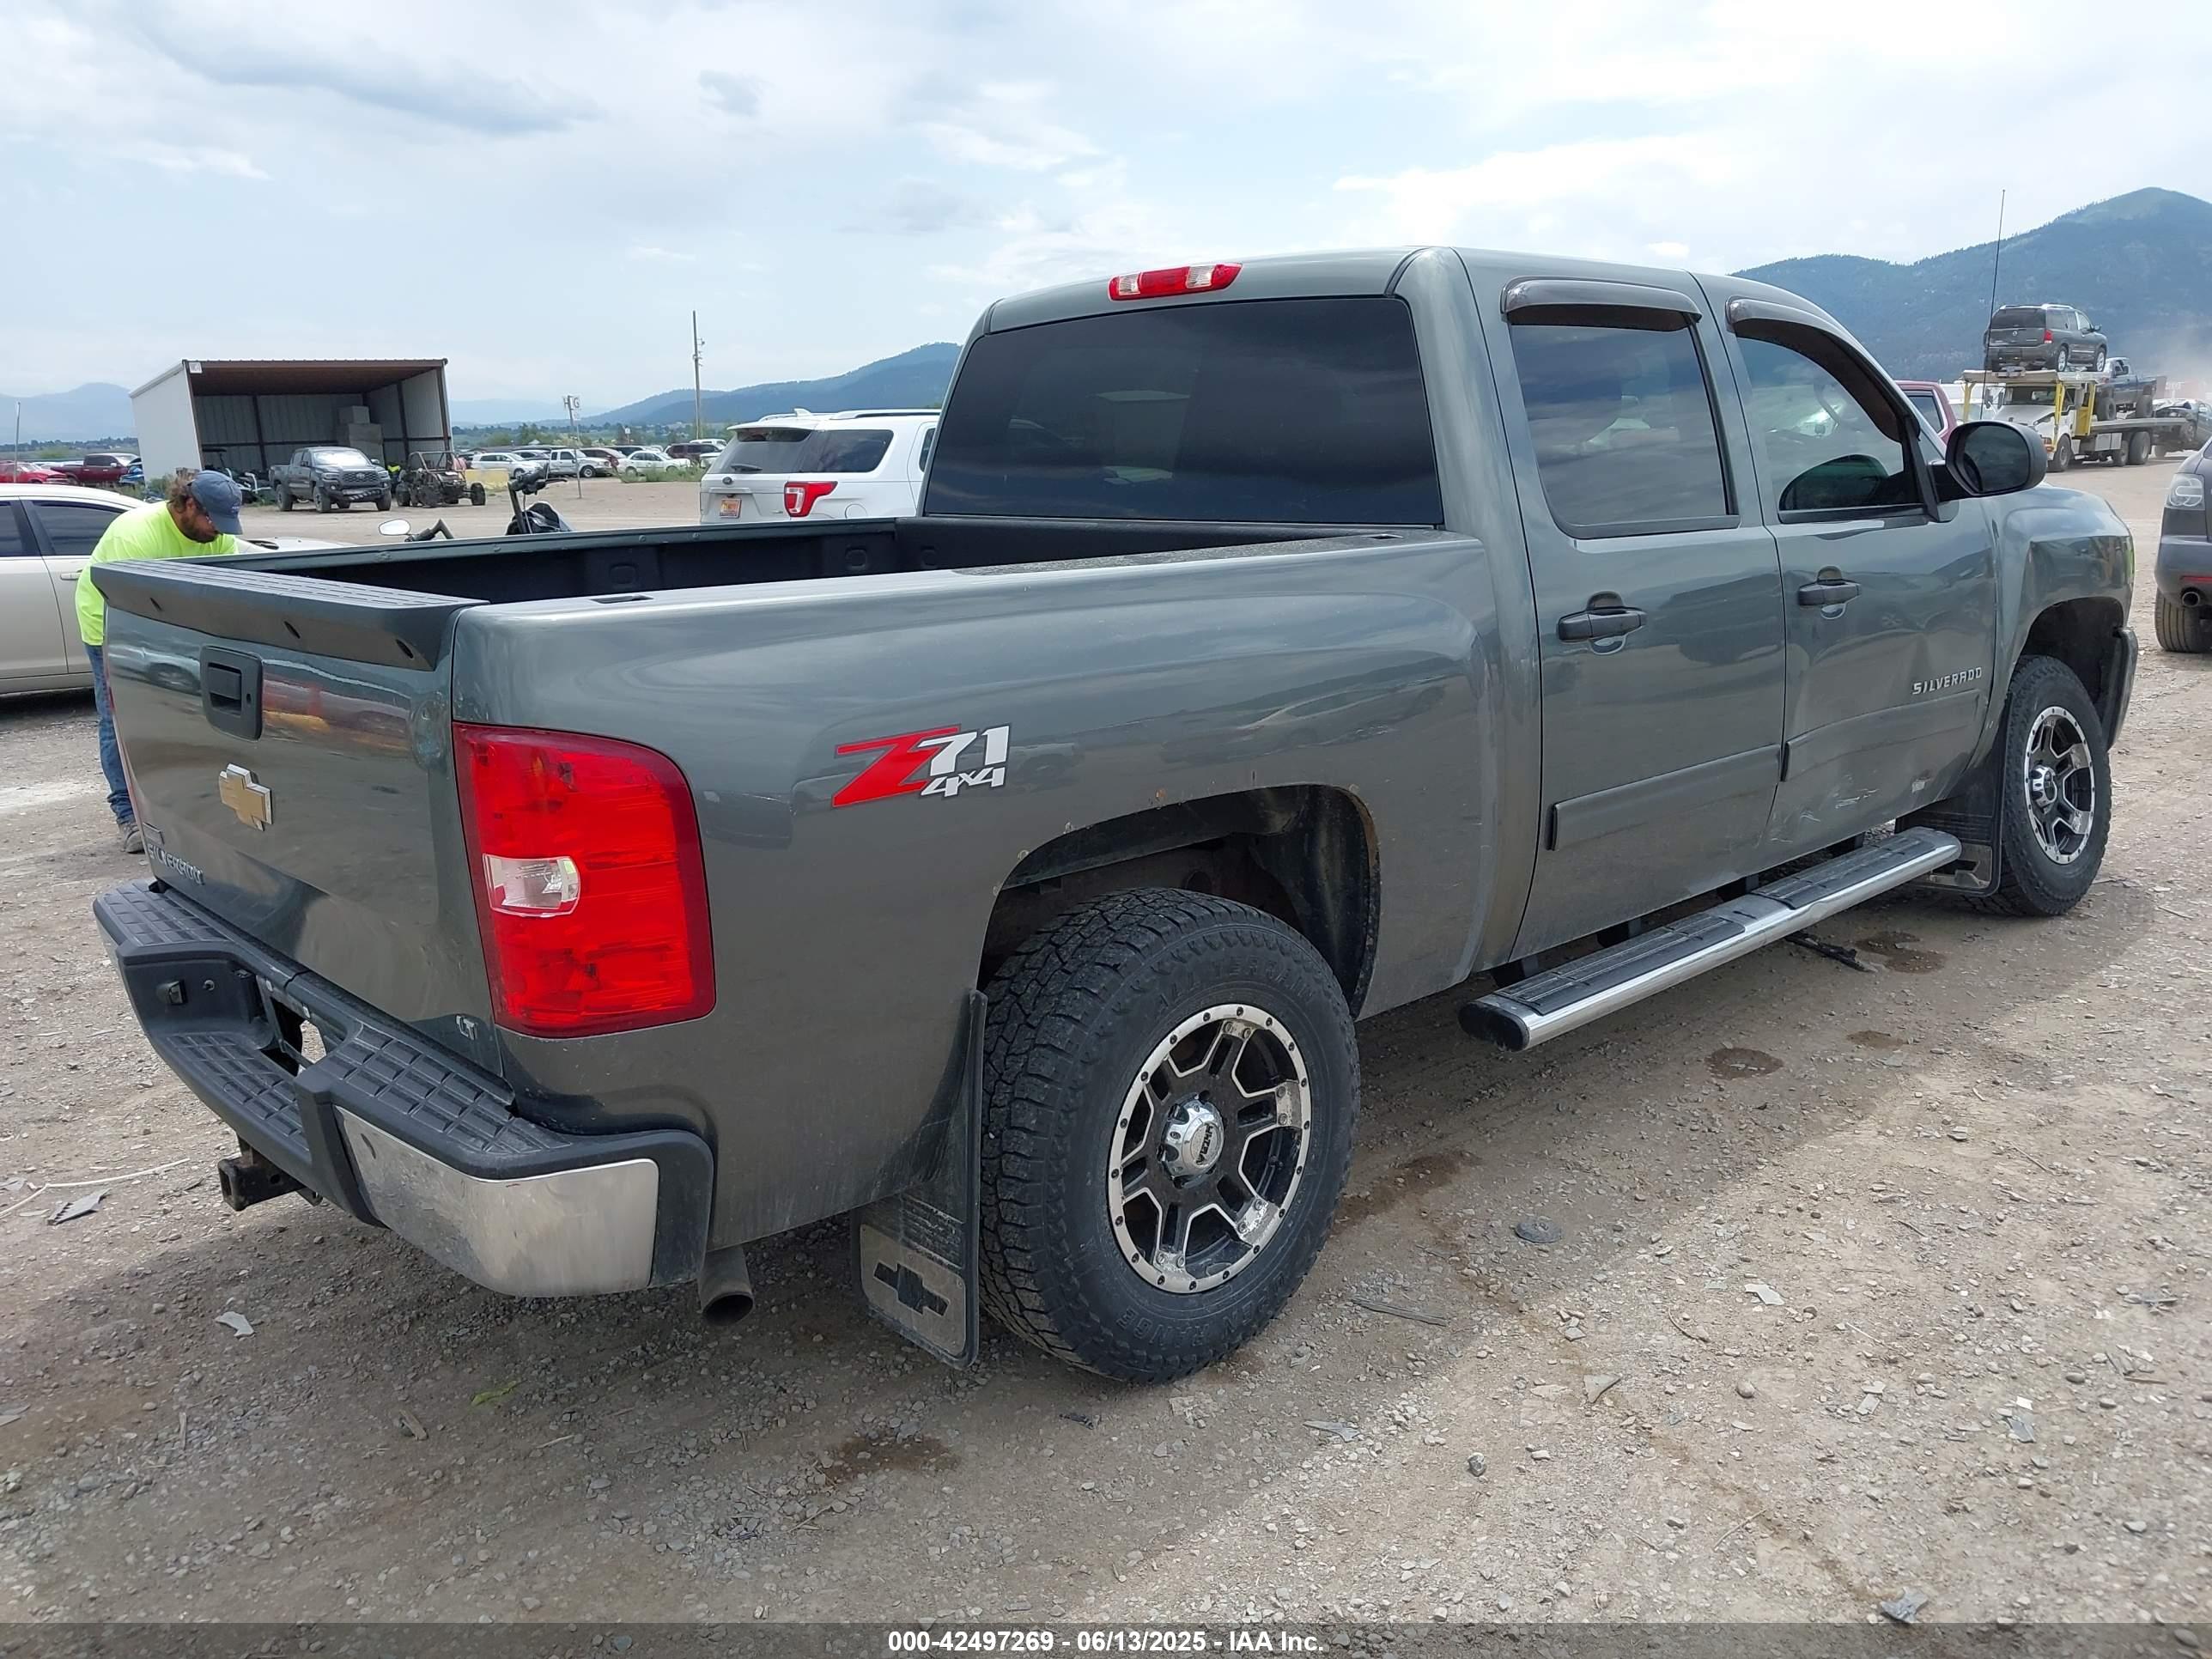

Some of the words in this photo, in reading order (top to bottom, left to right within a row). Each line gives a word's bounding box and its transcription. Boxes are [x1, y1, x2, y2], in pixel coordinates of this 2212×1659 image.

[574, 397, 580, 408] G
[1911, 666, 1983, 695] SILVERADO
[830, 723, 1012, 808] Z71
[147, 843, 205, 885] SILVERADO
[1212, 955, 1315, 1001] TERRAIN
[456, 1015, 477, 1041] LT
[1115, 1306, 1210, 1349] RANGE
